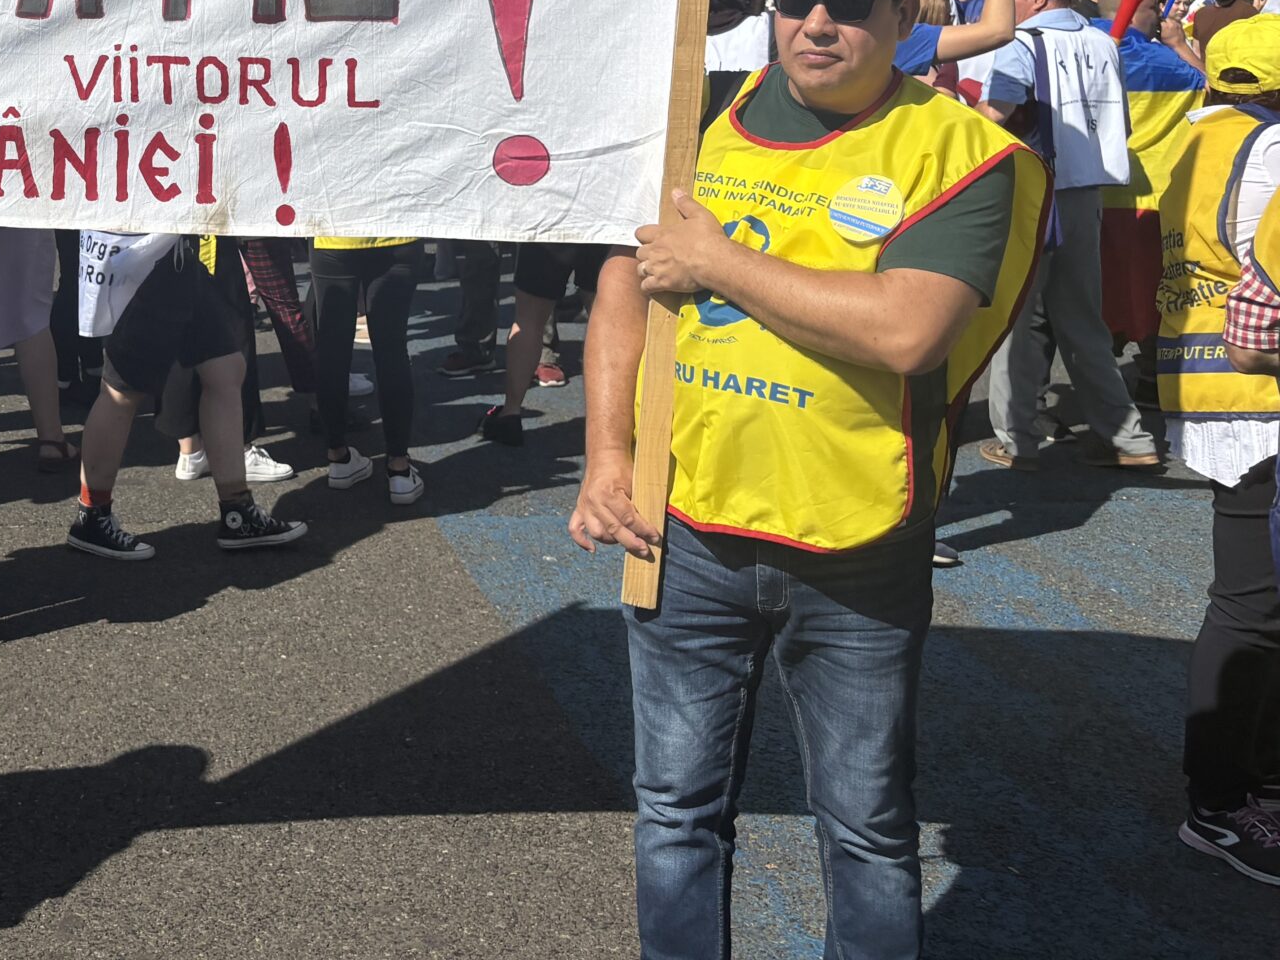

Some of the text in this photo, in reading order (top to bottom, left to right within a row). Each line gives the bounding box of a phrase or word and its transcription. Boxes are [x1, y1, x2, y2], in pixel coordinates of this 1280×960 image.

[64, 44, 380, 108] VIITORUL
[696, 171, 747, 189] ERATIA
[698, 187, 721, 200] DIN
[675, 361, 815, 409] RU HARET
